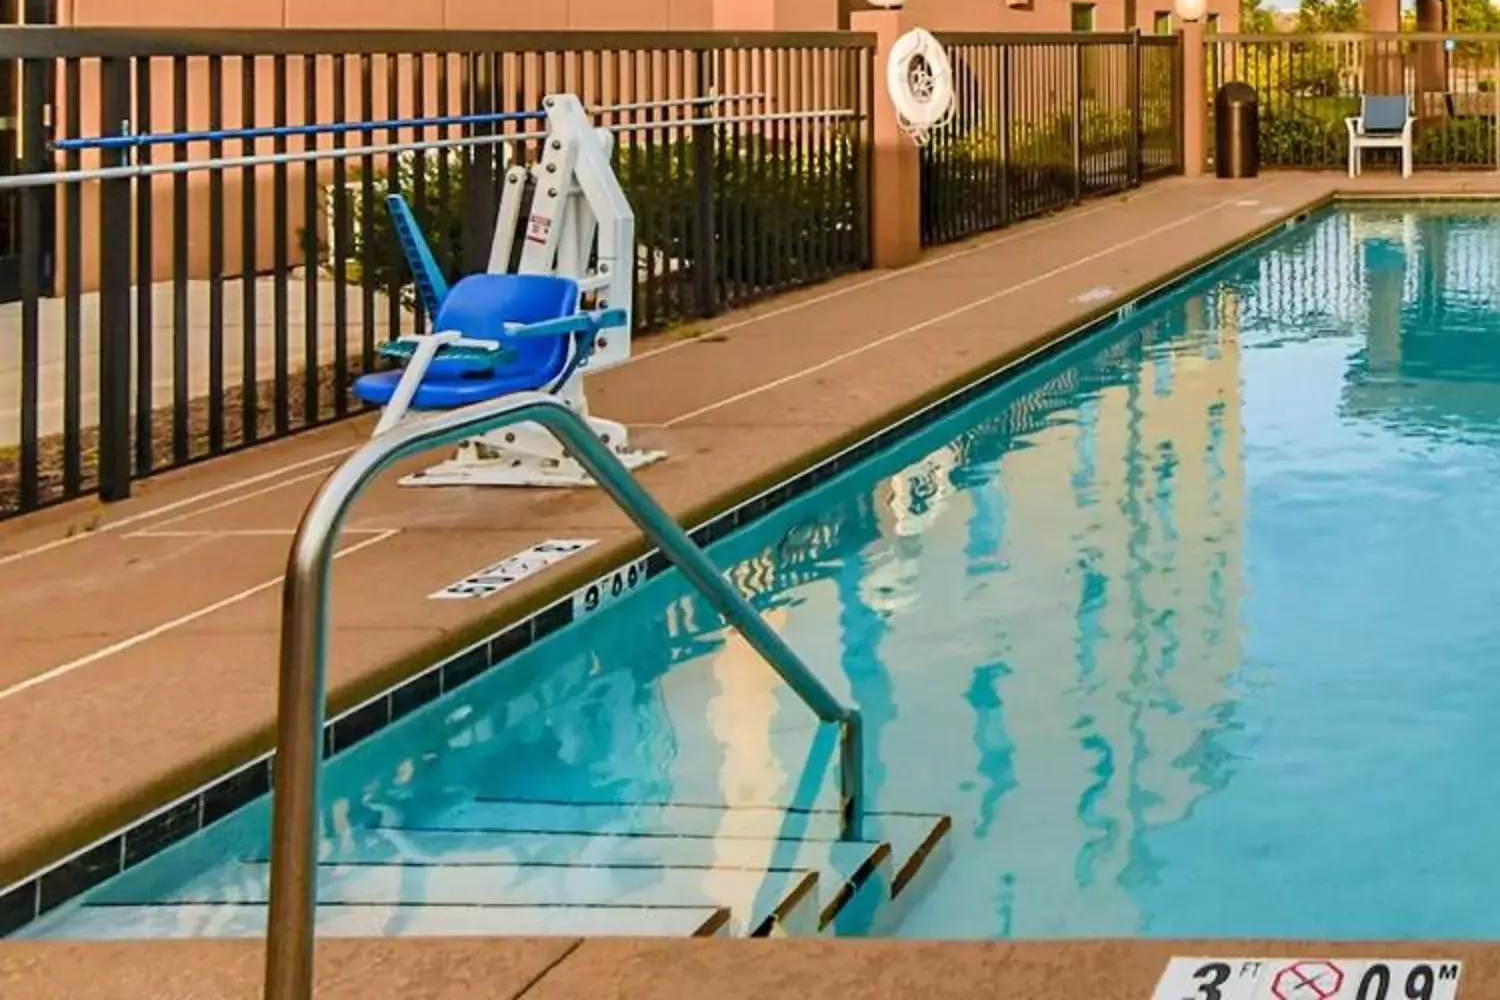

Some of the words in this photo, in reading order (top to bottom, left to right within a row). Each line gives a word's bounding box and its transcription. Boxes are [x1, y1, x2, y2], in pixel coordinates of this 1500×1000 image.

[1181, 961, 1232, 1000] 3
[1238, 962, 1263, 977] FT
[1438, 963, 1458, 980] M
